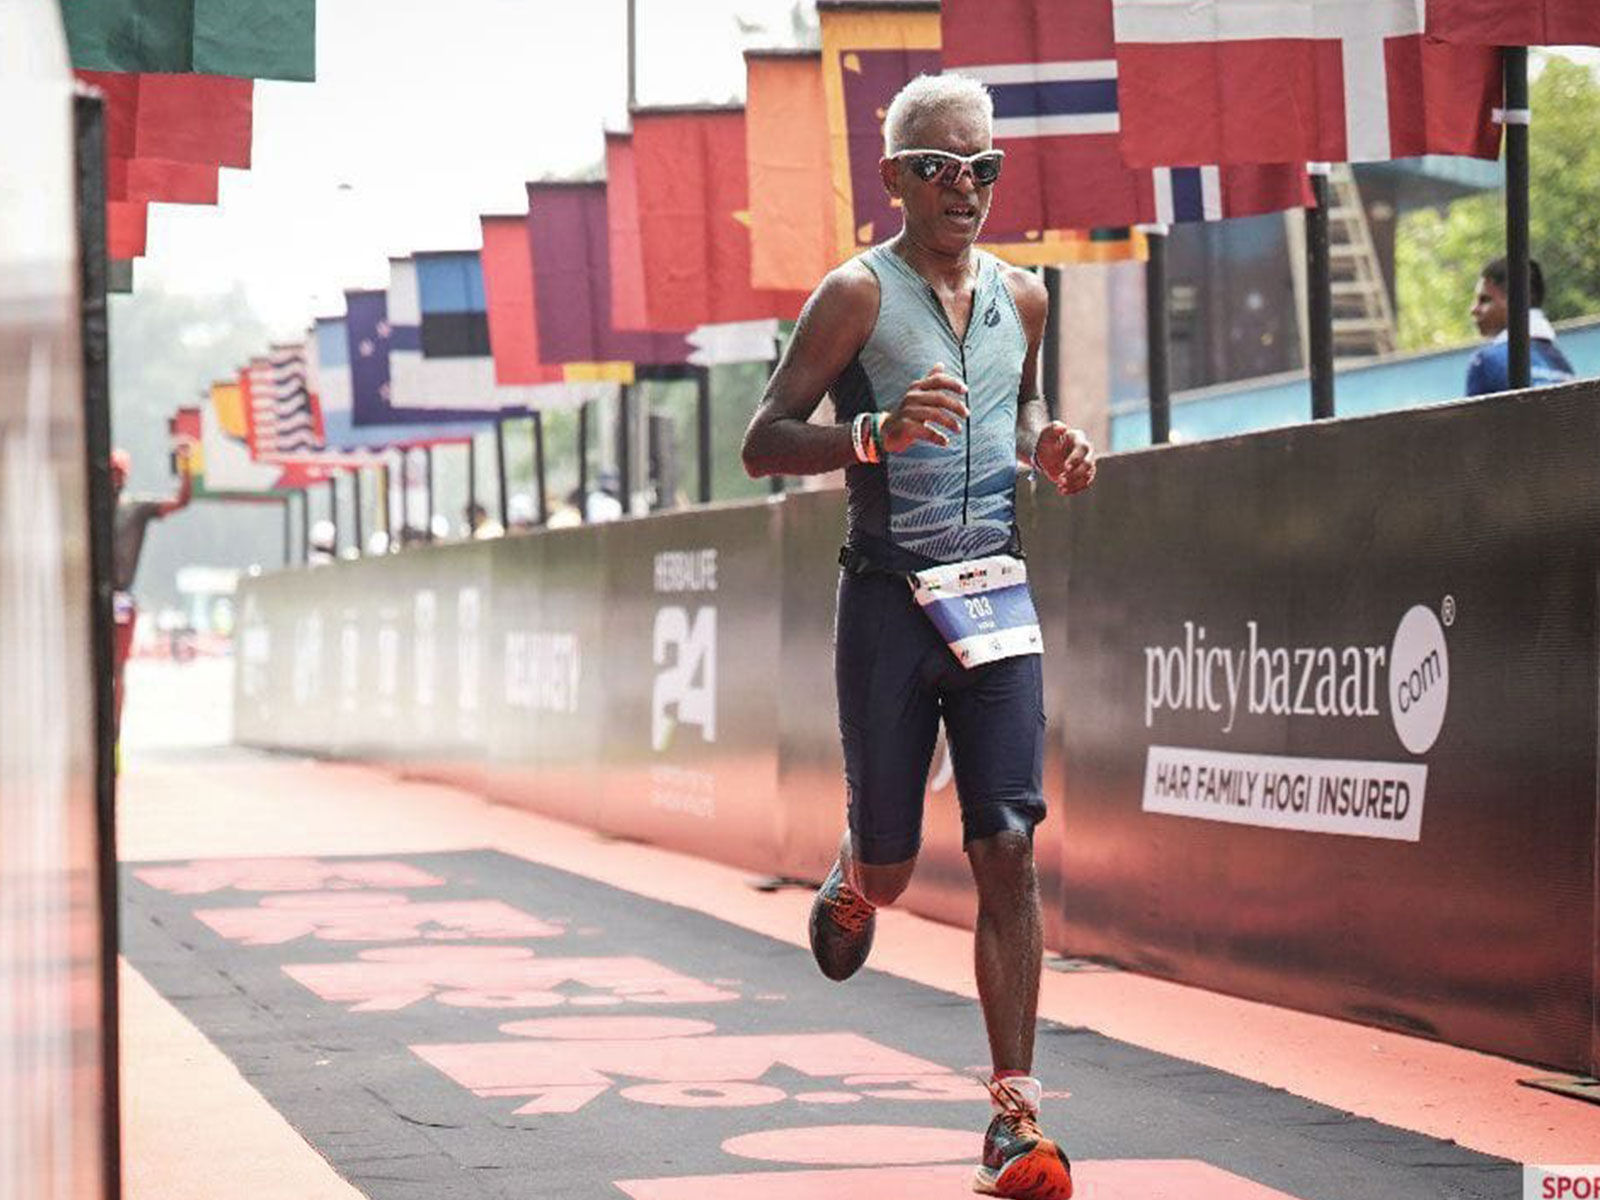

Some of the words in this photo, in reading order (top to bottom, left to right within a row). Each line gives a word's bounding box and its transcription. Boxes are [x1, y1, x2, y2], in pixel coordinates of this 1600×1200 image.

[964, 597, 993, 619] 203
[652, 606, 718, 751] 24
[1144, 621, 1385, 733] policybazaar
[1398, 650, 1441, 714] com
[1155, 764, 1191, 799] HAR
[1195, 767, 1260, 807] FAMILY
[1261, 773, 1314, 813] HOGI
[1316, 776, 1411, 822] INSURED
